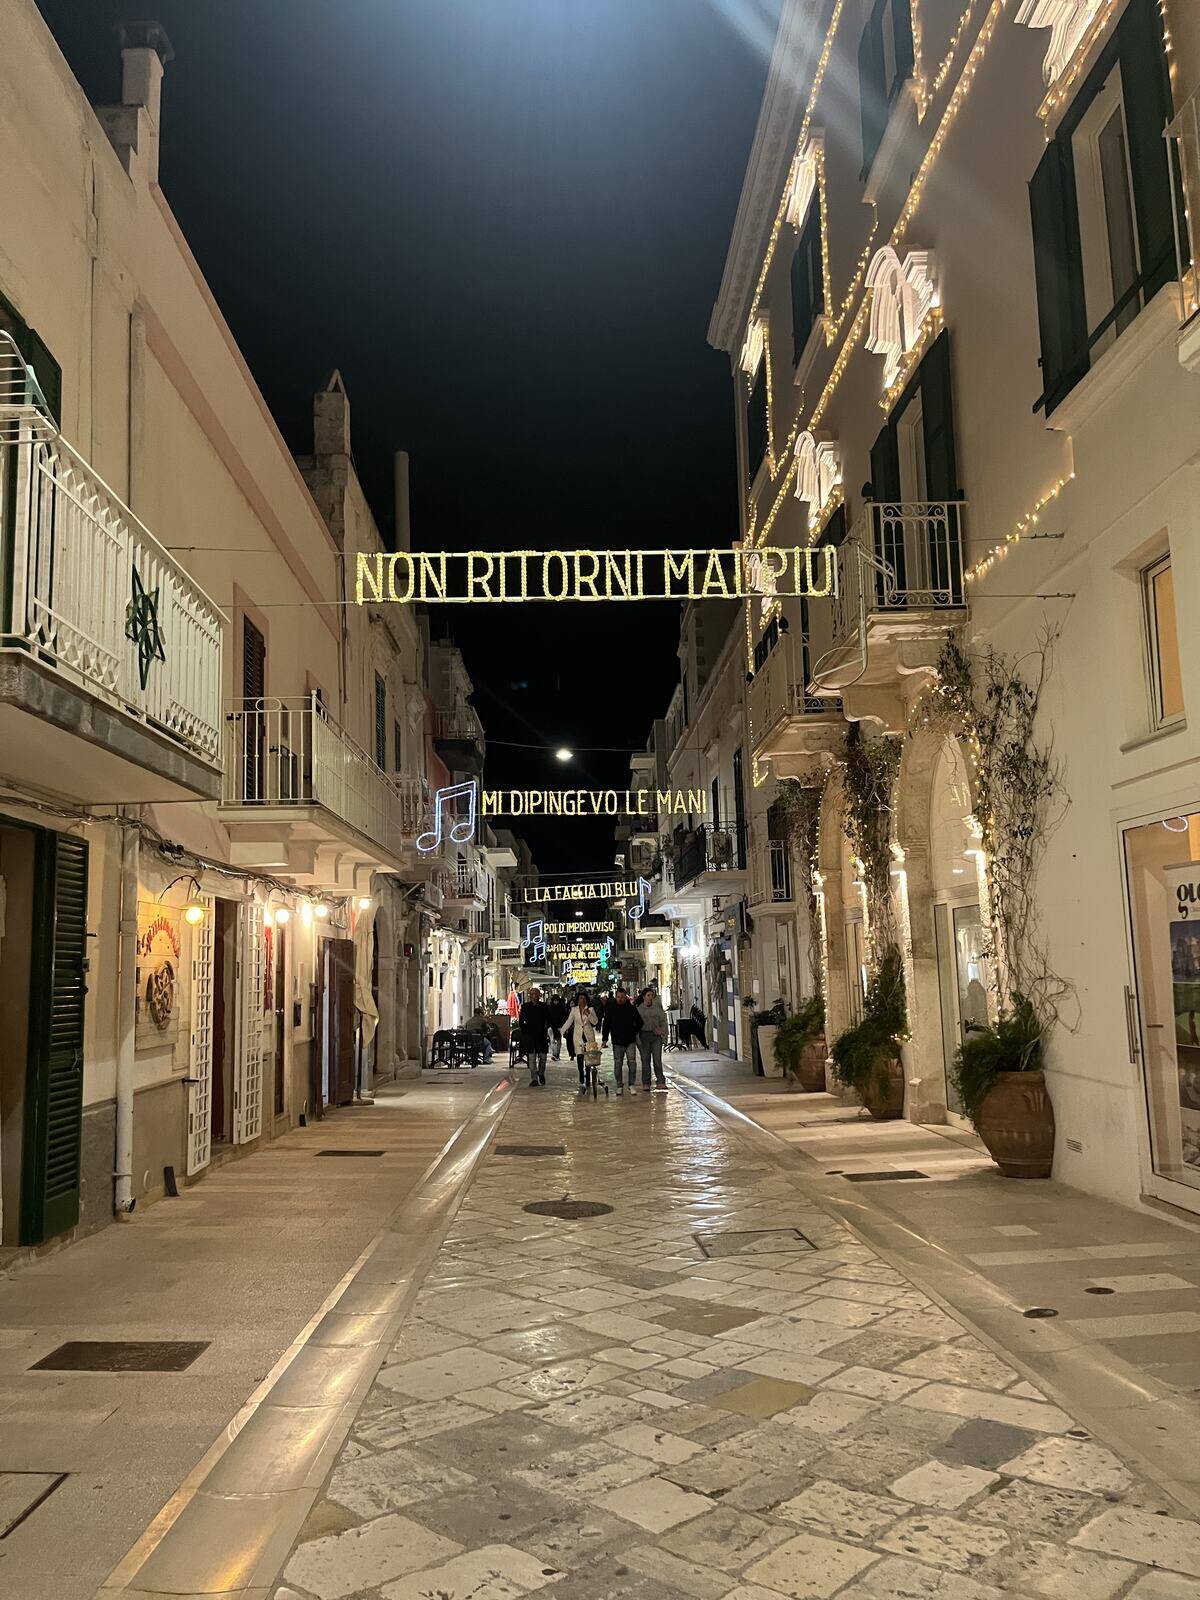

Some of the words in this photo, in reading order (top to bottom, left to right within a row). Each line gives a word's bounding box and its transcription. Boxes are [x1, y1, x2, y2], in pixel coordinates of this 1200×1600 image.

[356, 551, 446, 605] NON
[467, 549, 644, 603] RITORNI
[664, 548, 742, 599] MAI
[482, 790, 502, 815] MI
[510, 790, 618, 815] DIPINGEVO
[626, 789, 649, 815] LE
[656, 789, 707, 814] MANI
[535, 886, 552, 902] LA
[555, 884, 597, 900] FACCIA
[600, 882, 612, 898] DI
[615, 881, 638, 897] BLU
[544, 923, 557, 933] POI
